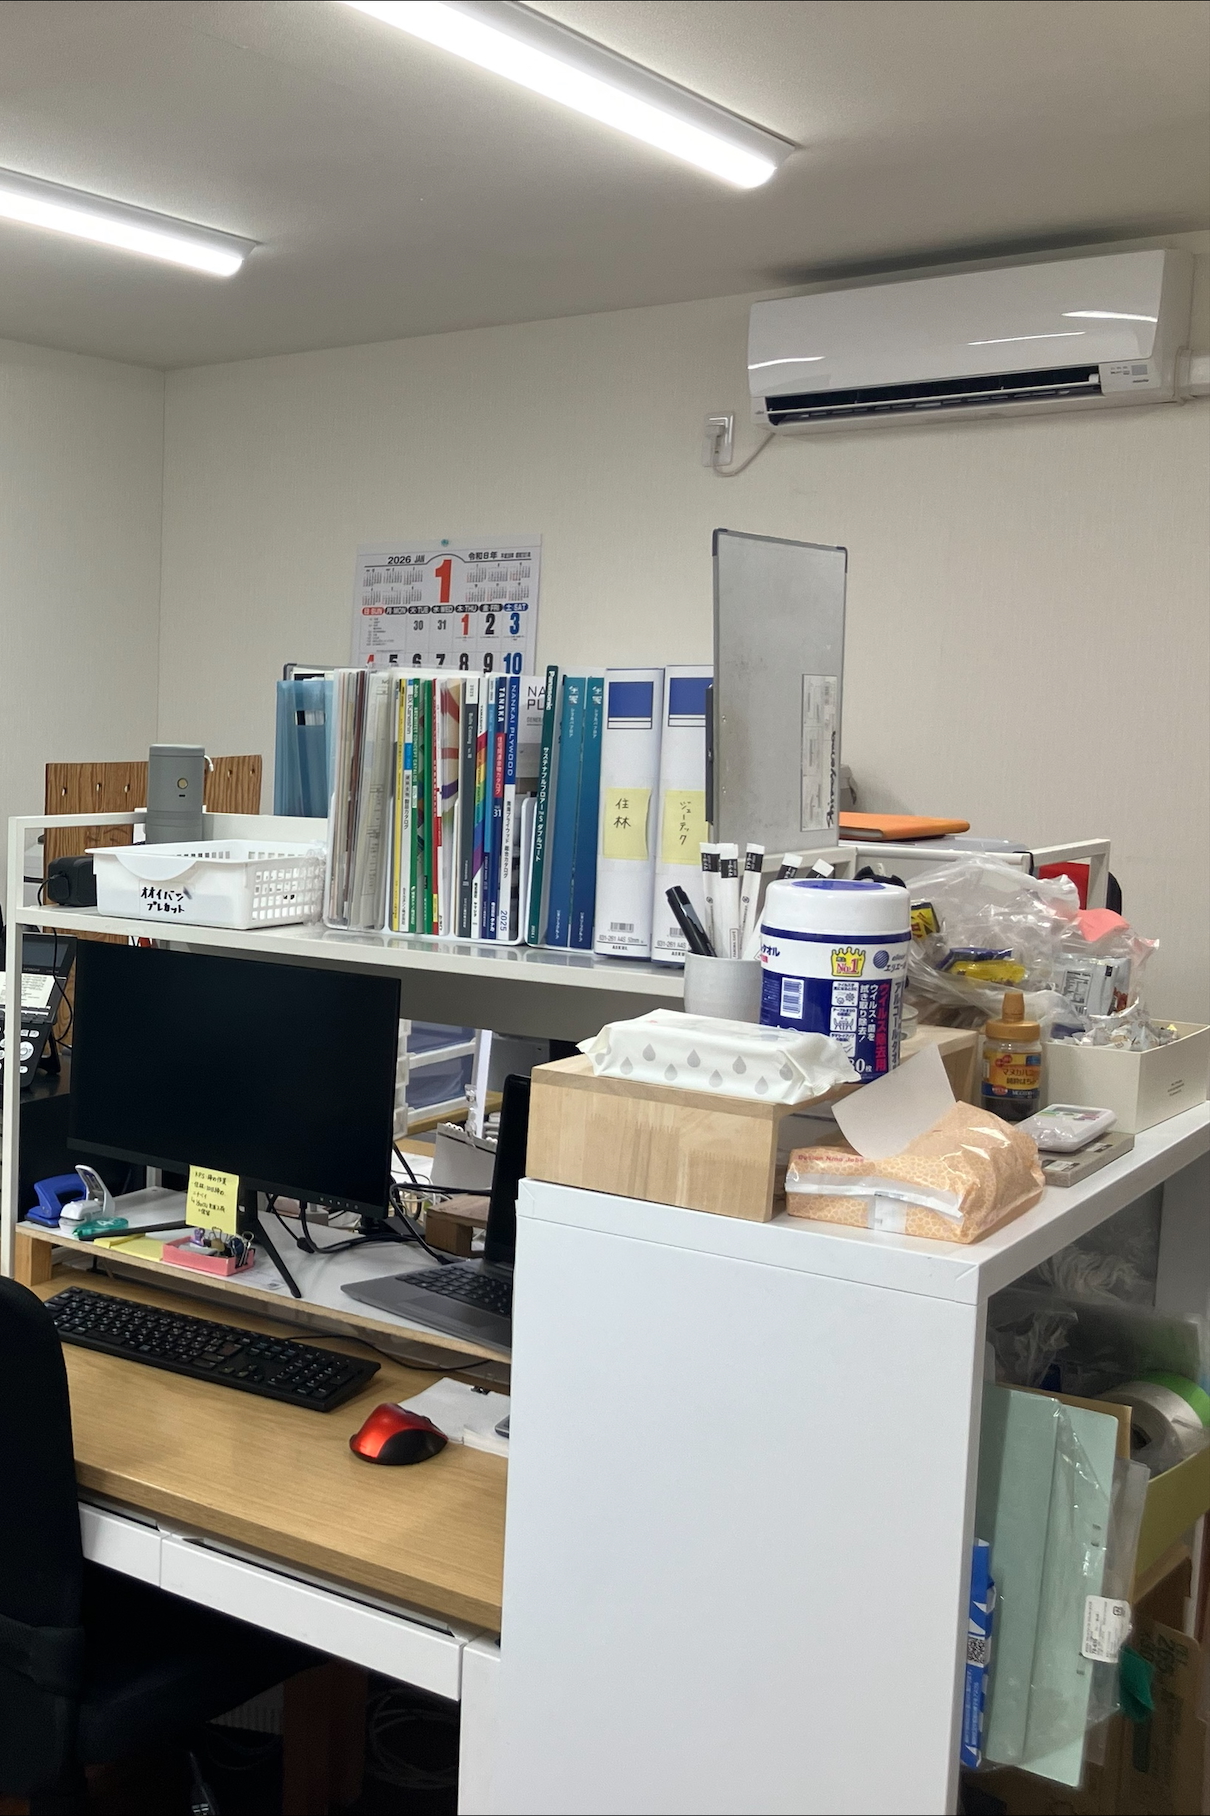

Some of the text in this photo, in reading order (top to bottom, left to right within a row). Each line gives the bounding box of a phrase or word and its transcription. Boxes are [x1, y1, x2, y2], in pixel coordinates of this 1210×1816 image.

[388, 555, 425, 564] 2026 JAN
[468, 551, 497, 560] 令和8年
[435, 559, 452, 603] 1
[513, 603, 526, 611] SAT
[413, 612, 520, 635] 30 31 1 2 3
[459, 653, 469, 671] 8
[483, 652, 493, 673] 9
[503, 652, 522, 675] 10
[546, 671, 556, 711] Panasonic
[508, 727, 516, 776] PLYWOOD
[493, 809, 501, 818] 31
[613, 798, 631, 829] 住林
[679, 800, 692, 846] ジューテック
[147, 901, 185, 914] プレカット
[499, 910, 508, 932] 2025
[875, 983, 889, 1072] ウイルス除去用
